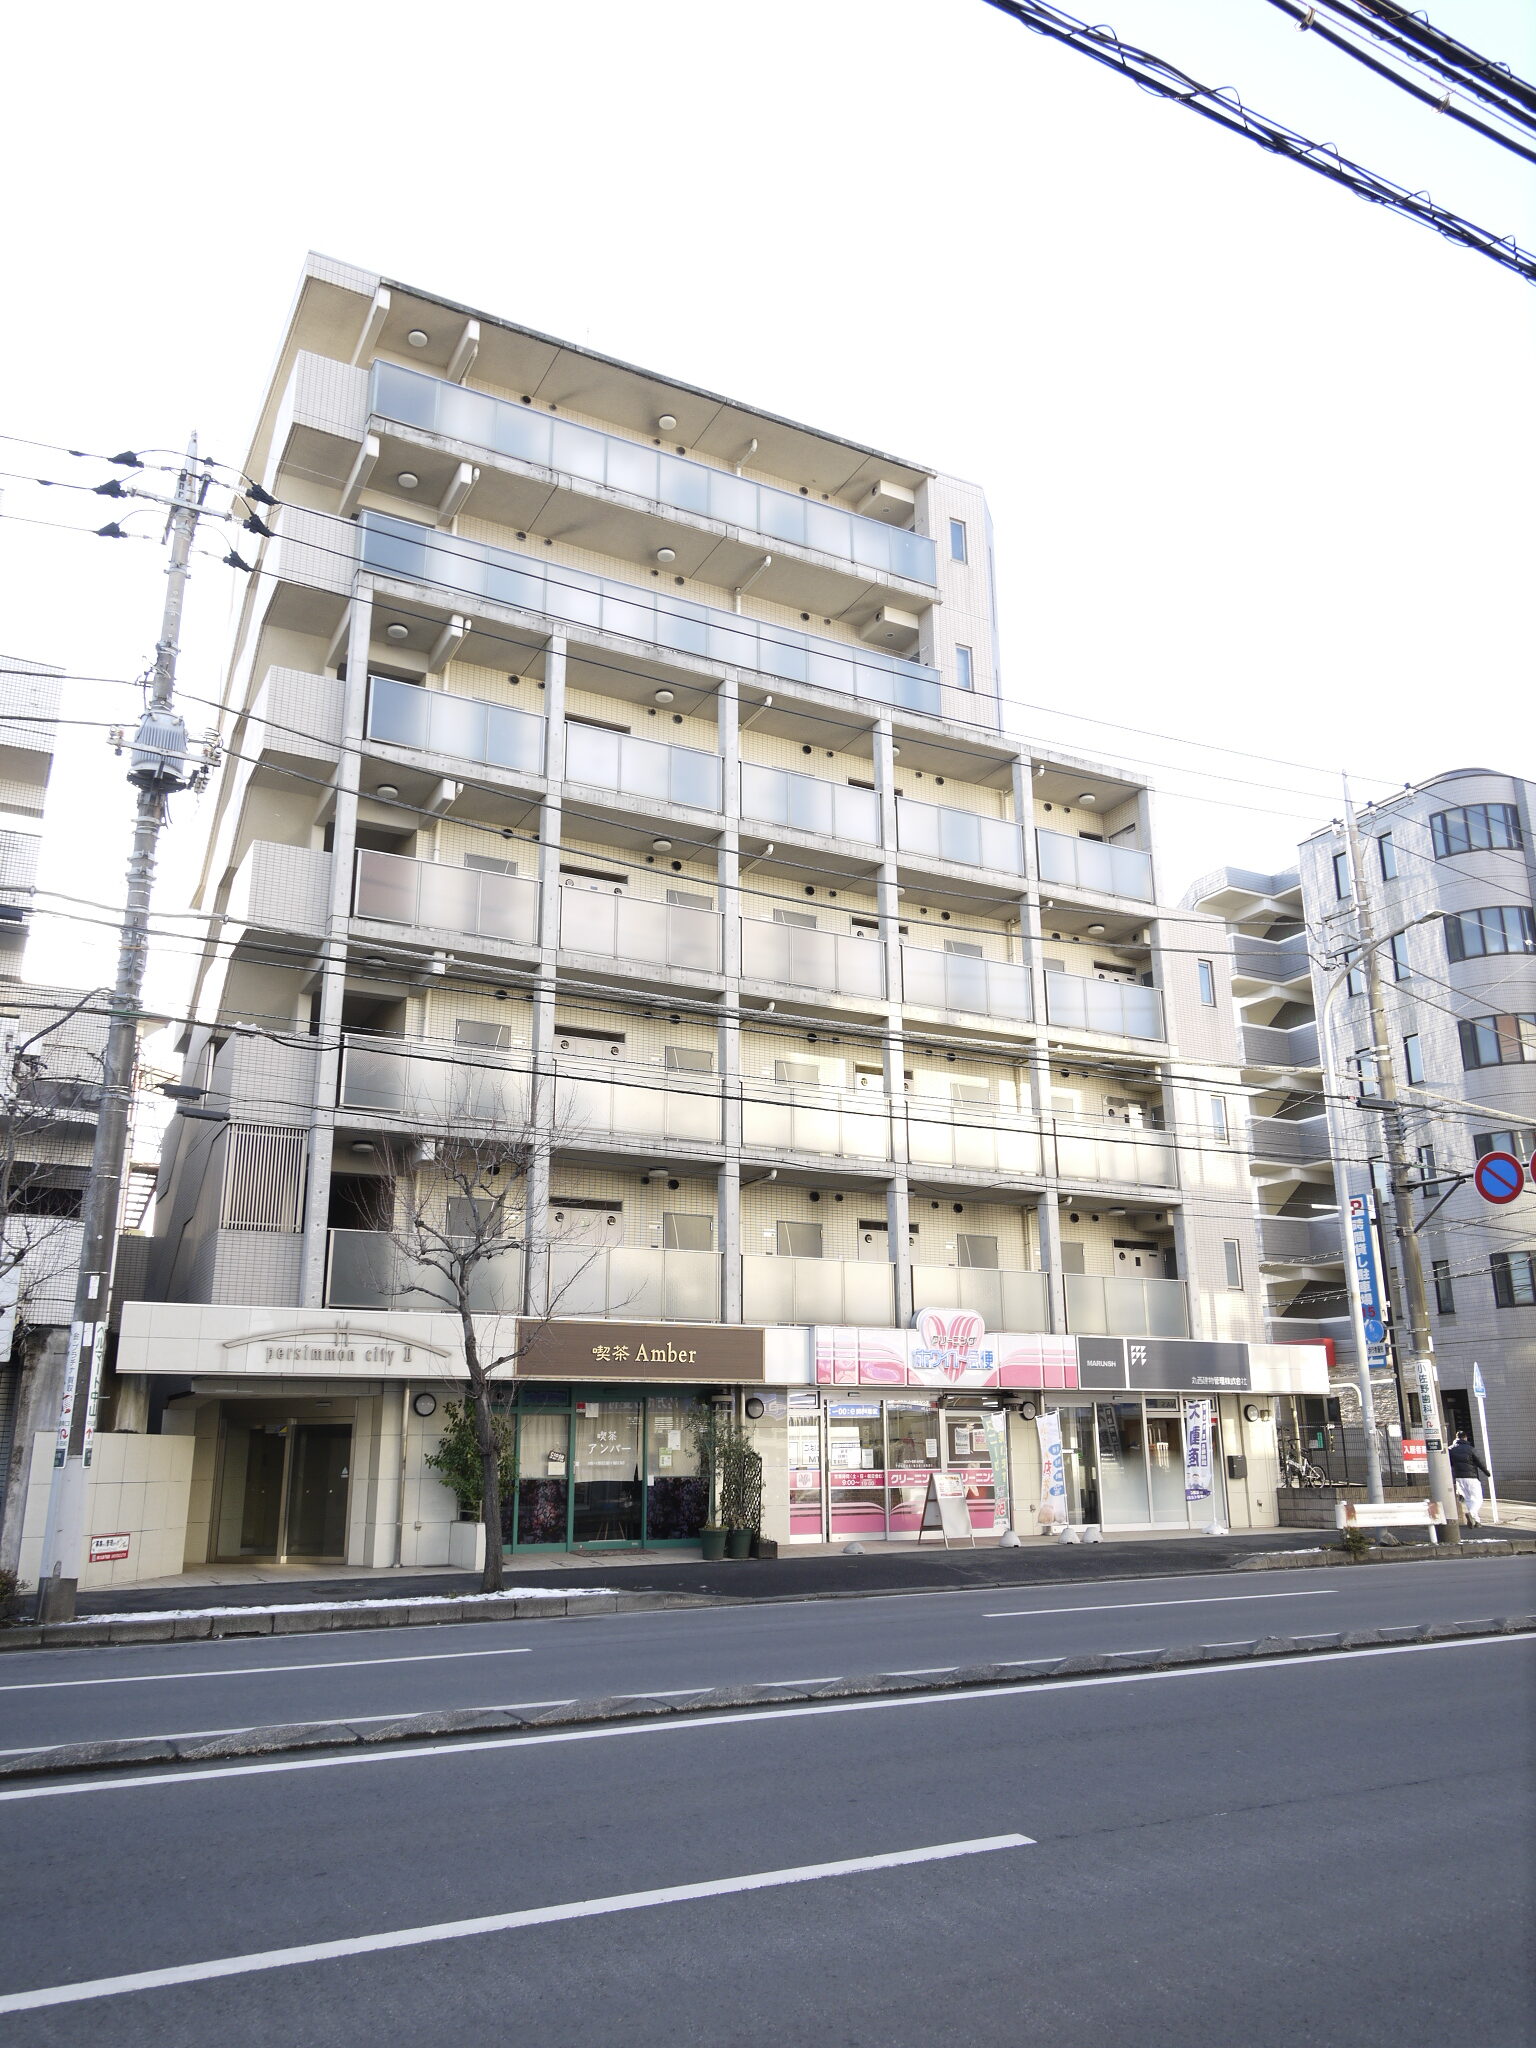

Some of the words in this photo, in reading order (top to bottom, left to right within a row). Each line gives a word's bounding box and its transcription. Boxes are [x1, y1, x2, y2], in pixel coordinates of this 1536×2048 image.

[266, 1344, 355, 1364] persimmon
[365, 1346, 395, 1366] city
[592, 1345, 630, 1362] 喫茶
[635, 1341, 697, 1363] Amber
[597, 1430, 617, 1442] 喫茶
[588, 1443, 632, 1455] アンバー
